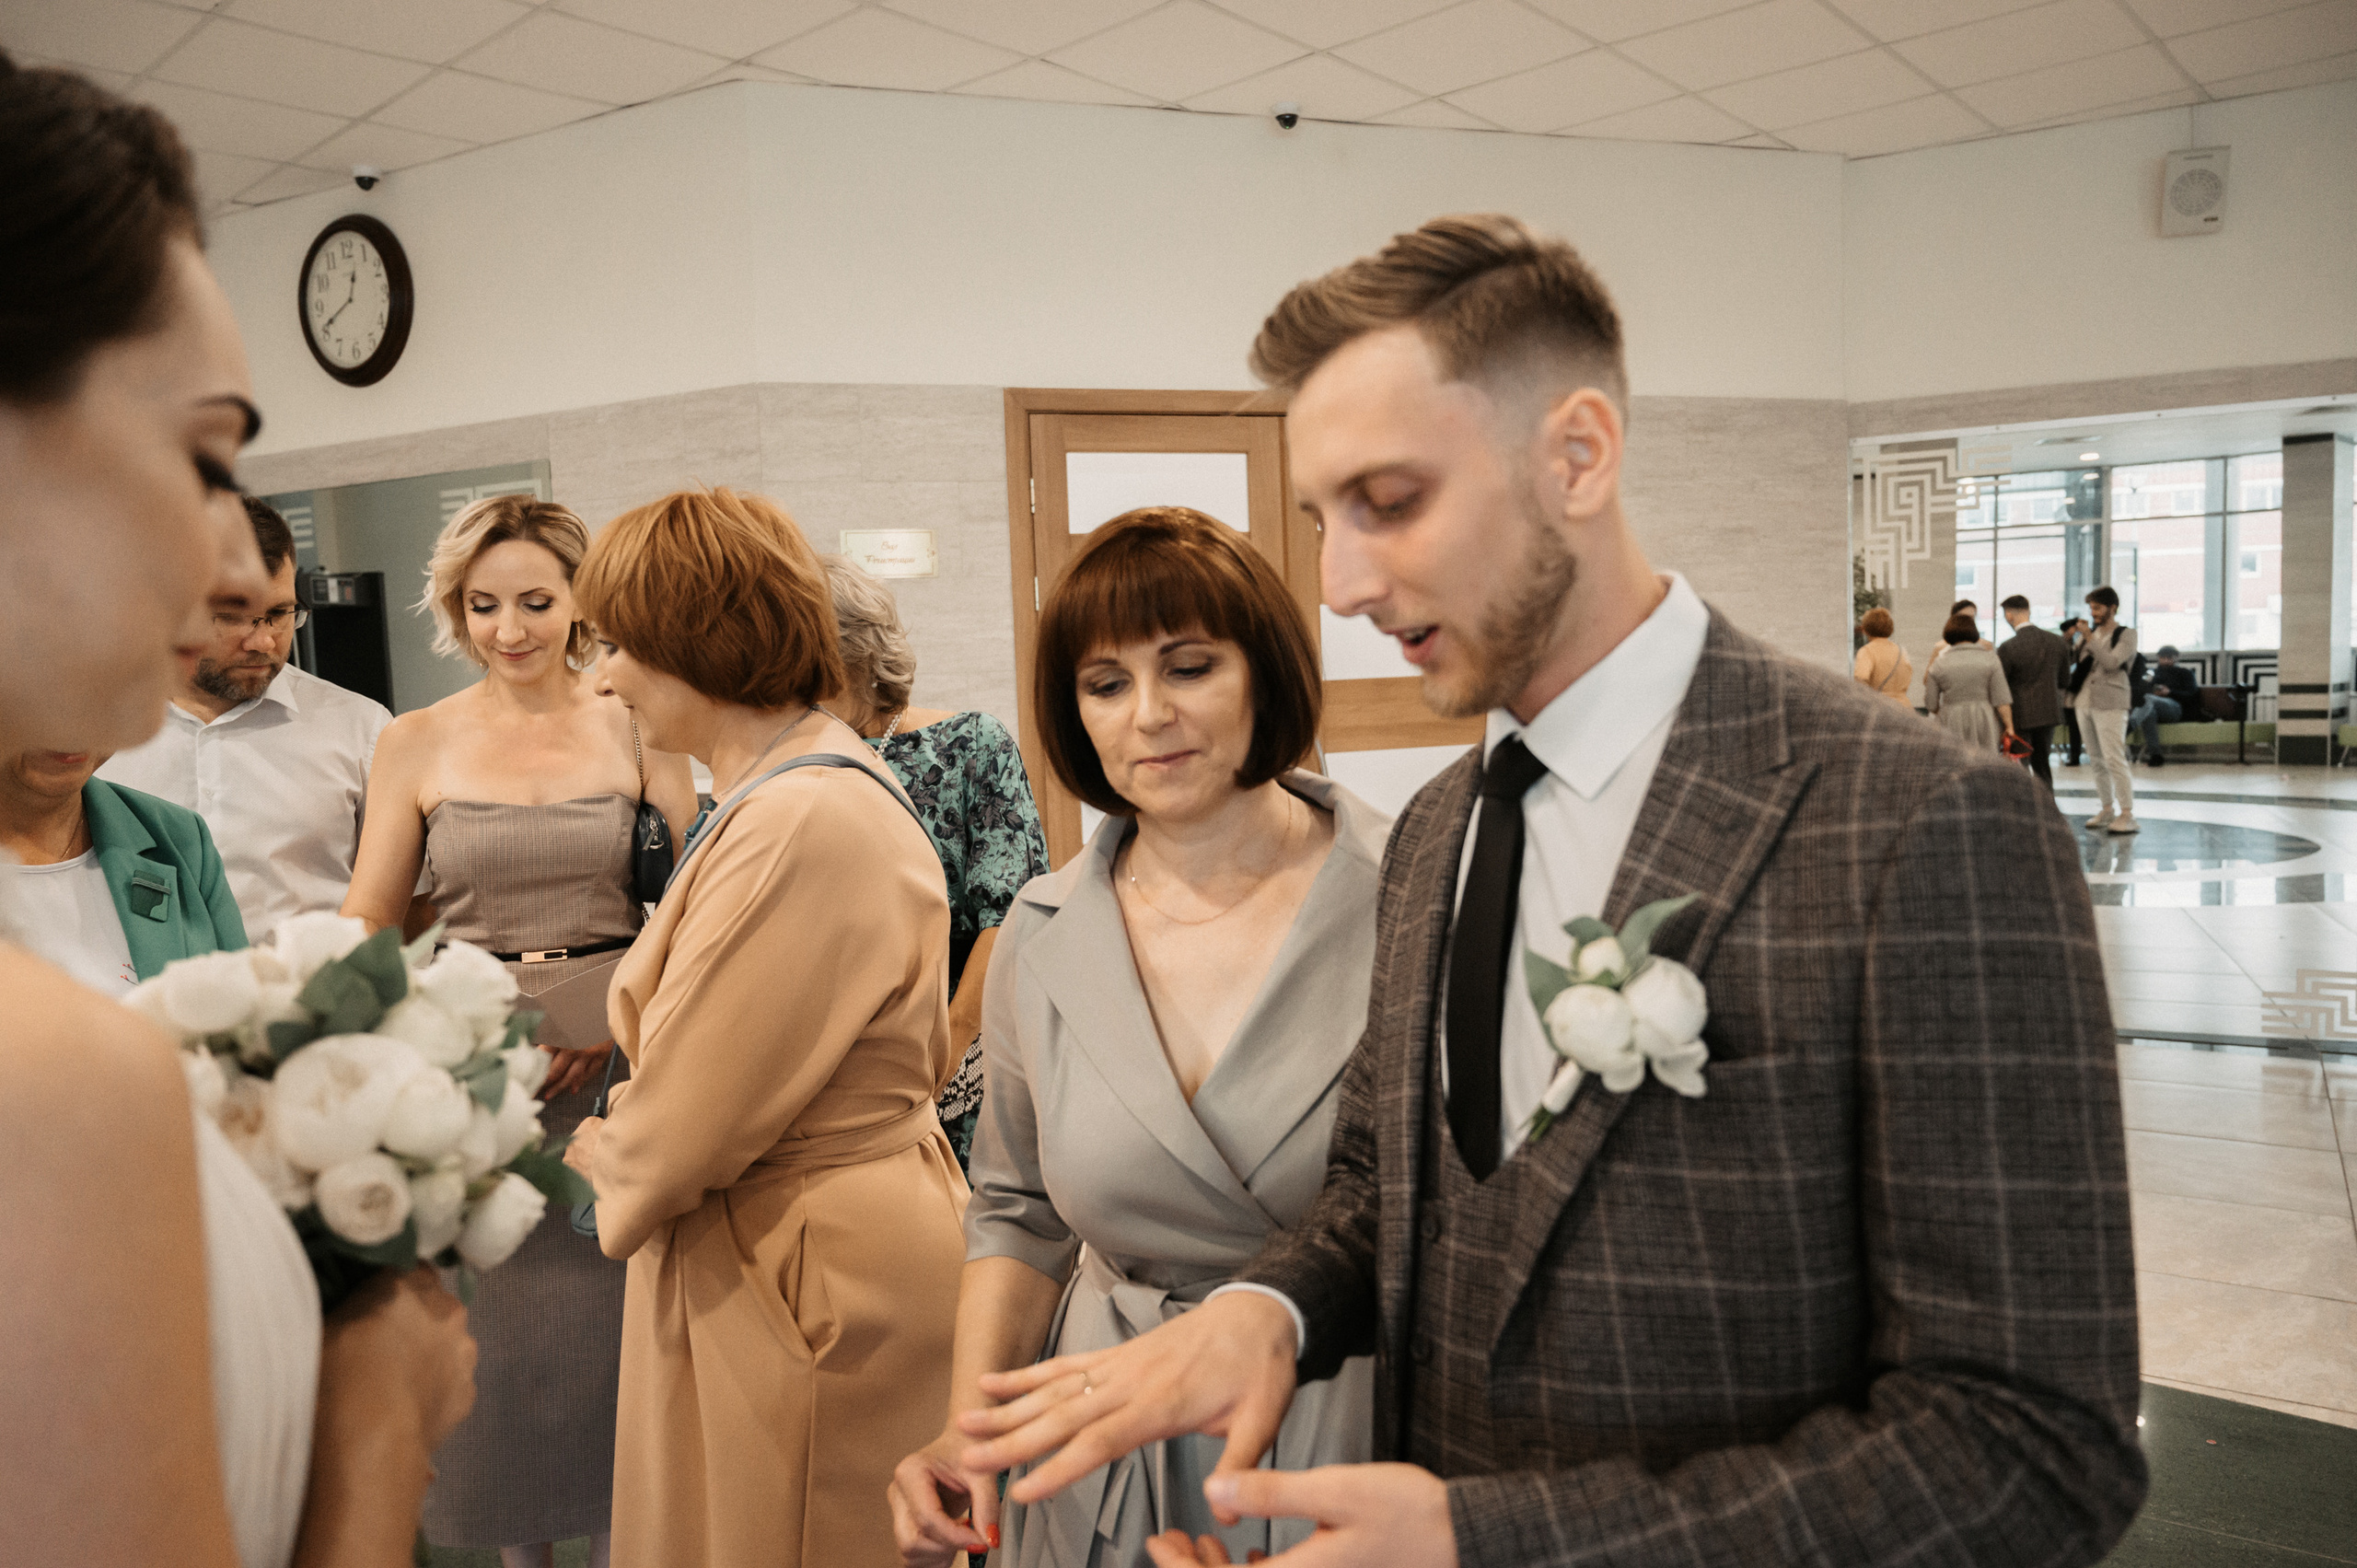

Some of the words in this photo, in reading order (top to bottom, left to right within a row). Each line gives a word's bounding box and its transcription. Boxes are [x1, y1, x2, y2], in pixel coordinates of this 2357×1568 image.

[341, 240, 353, 259] 12
[360, 244, 366, 262] 1
[325, 251, 336, 270] 11
[373, 259, 381, 277] 2
[316, 273, 330, 293] 10
[315, 298, 324, 318] 9
[377, 311, 385, 330] 4
[322, 324, 331, 342] 8
[367, 332, 377, 352] 5
[335, 337, 343, 356] 7
[352, 341, 361, 360] 6
